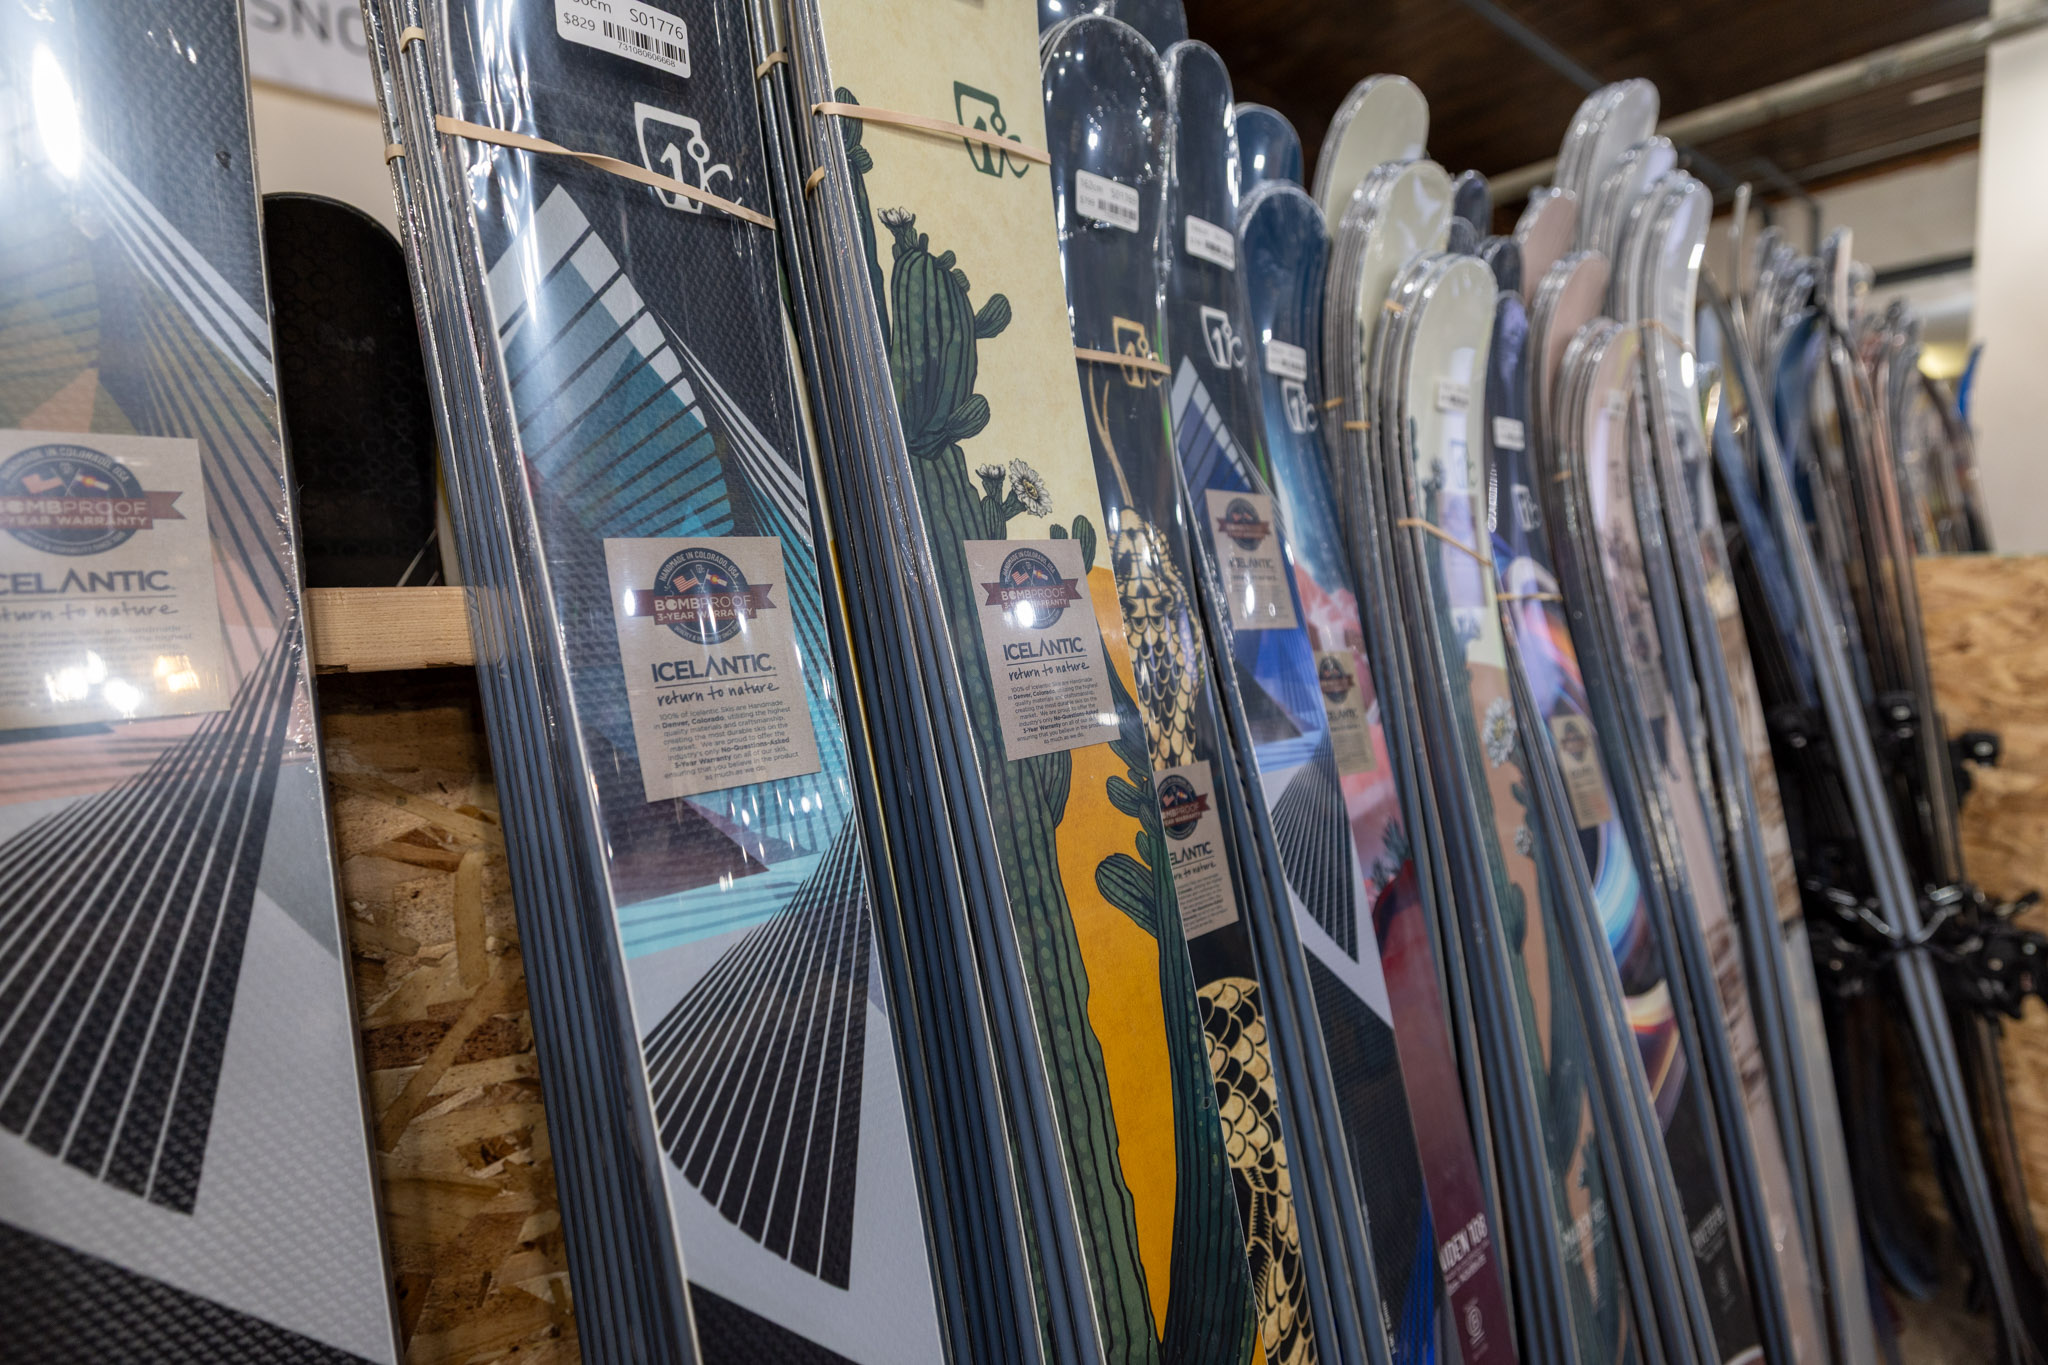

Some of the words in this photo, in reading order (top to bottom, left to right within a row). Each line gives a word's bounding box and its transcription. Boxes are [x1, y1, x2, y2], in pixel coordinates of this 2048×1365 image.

[563, 12, 596, 32] $829
[629, 8, 684, 40] S01776
[57, 516, 147, 526] WARRANTY
[658, 553, 686, 582] HANDMADE
[686, 551, 694, 559] IN
[727, 564, 740, 578] USA
[654, 594, 751, 611] BOMBPROOF
[1001, 587, 1065, 601] BOMBPROOF
[60, 603, 87, 621] to
[95, 601, 179, 617] nature
[656, 611, 695, 622] 3-YEAR
[1008, 667, 1041, 681] return
[1042, 663, 1054, 677] to
[1056, 660, 1090, 673] nature
[656, 690, 704, 707] return
[707, 685, 724, 700] to
[729, 681, 780, 697] nature
[661, 719, 690, 728] Denver,
